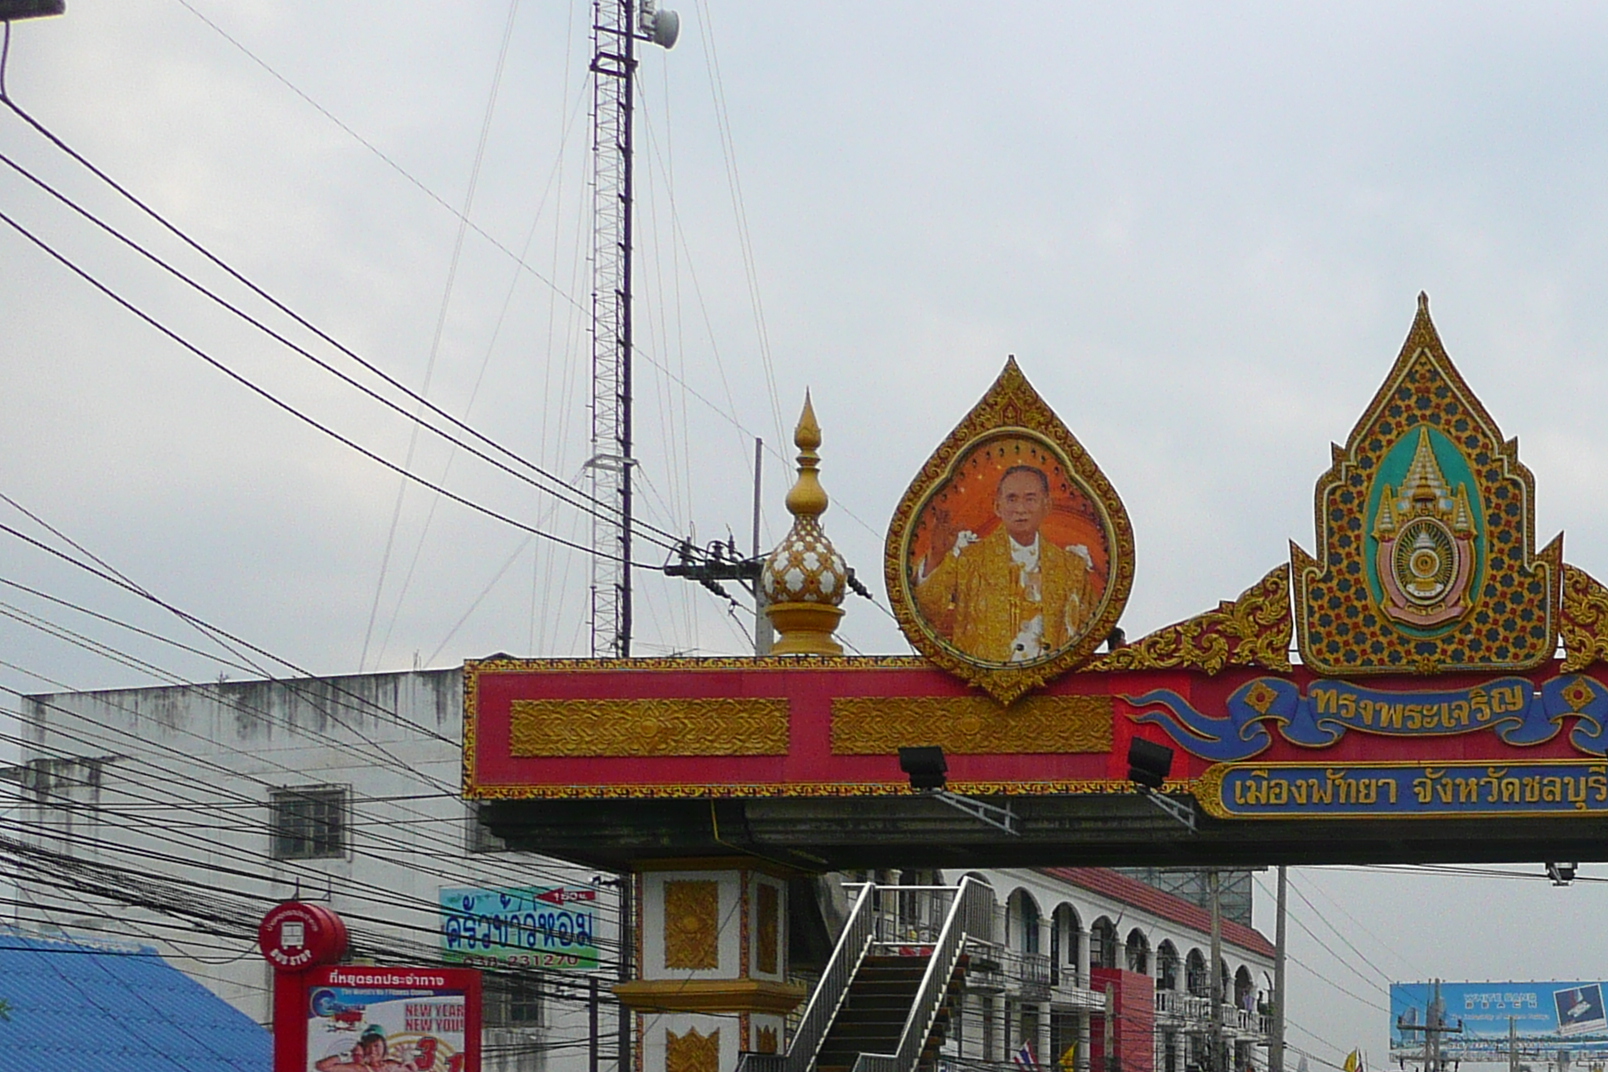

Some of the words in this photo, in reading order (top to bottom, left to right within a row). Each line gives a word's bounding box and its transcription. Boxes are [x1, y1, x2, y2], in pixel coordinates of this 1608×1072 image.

[1310, 683, 1524, 729] ทรงพระเจริญ
[1234, 769, 1398, 806] เมืองพัทยา
[1412, 767, 1608, 810] จังหวัดชลบุรี
[270, 948, 289, 965] BUS
[290, 949, 312, 966] STOP
[405, 1004, 432, 1017] NEW
[436, 1004, 465, 1017] YEAR
[405, 1019, 432, 1032] NEW
[436, 1019, 465, 1032] YOU!
[414, 1036, 438, 1071] 3
